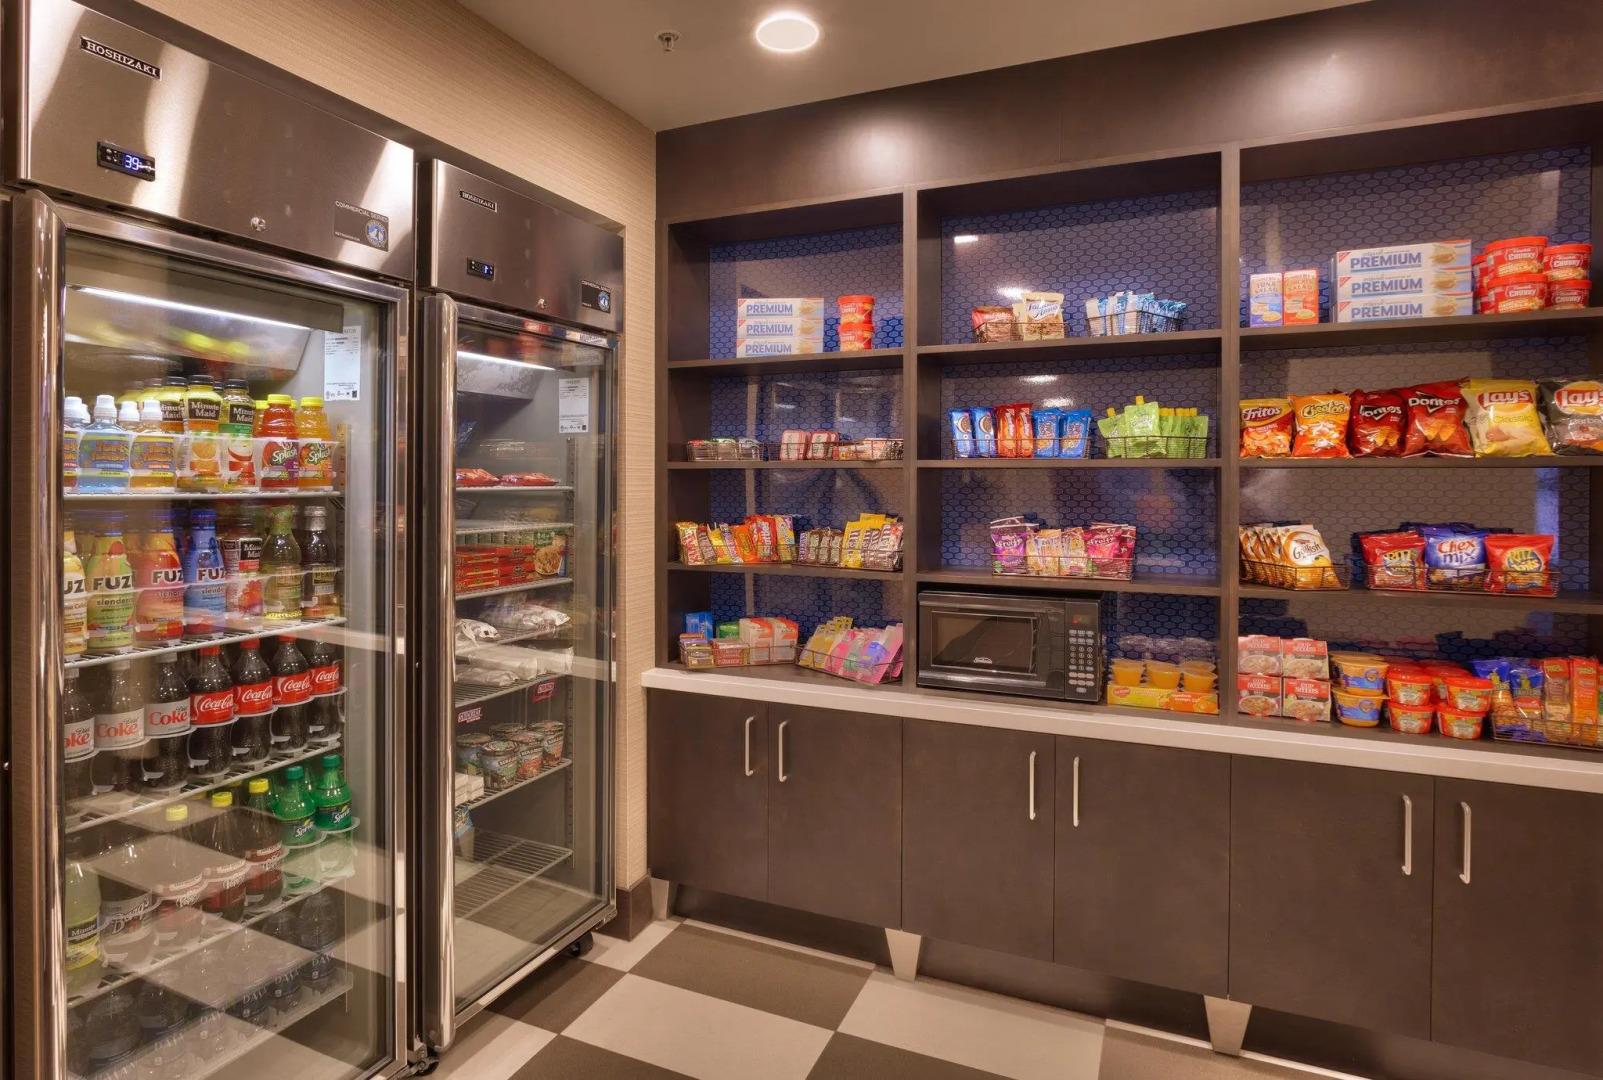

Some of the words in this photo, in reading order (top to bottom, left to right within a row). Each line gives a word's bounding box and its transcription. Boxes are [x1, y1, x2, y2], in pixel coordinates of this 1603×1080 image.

[85, 40, 158, 77] HOSHIZAKI
[124, 154, 140, 171] 39
[462, 191, 495, 209] HOSHIZAKI
[335, 200, 370, 217] COMMERCIAL
[1350, 252, 1422, 269] PREMIUM
[1351, 277, 1423, 294] PREMIUM
[746, 304, 793, 314] PREMIUM
[1351, 303, 1423, 319] PREMIUM
[746, 324, 793, 334] PREMIUM
[745, 344, 792, 354] PREMIUM
[190, 401, 220, 411] Minute
[1408, 397, 1461, 408] Doritos
[1483, 390, 1530, 407] Lay's
[195, 409, 216, 418] Maid
[1242, 406, 1281, 420] Fritos
[1302, 402, 1346, 418] Cheetos
[1359, 405, 1402, 417] Doritos
[272, 448, 298, 463] Splash
[1437, 537, 1477, 554] Chex
[1443, 551, 1477, 565] mix
[149, 711, 188, 726] Coke
[96, 722, 138, 739] Coke
[65, 733, 90, 748] oke
